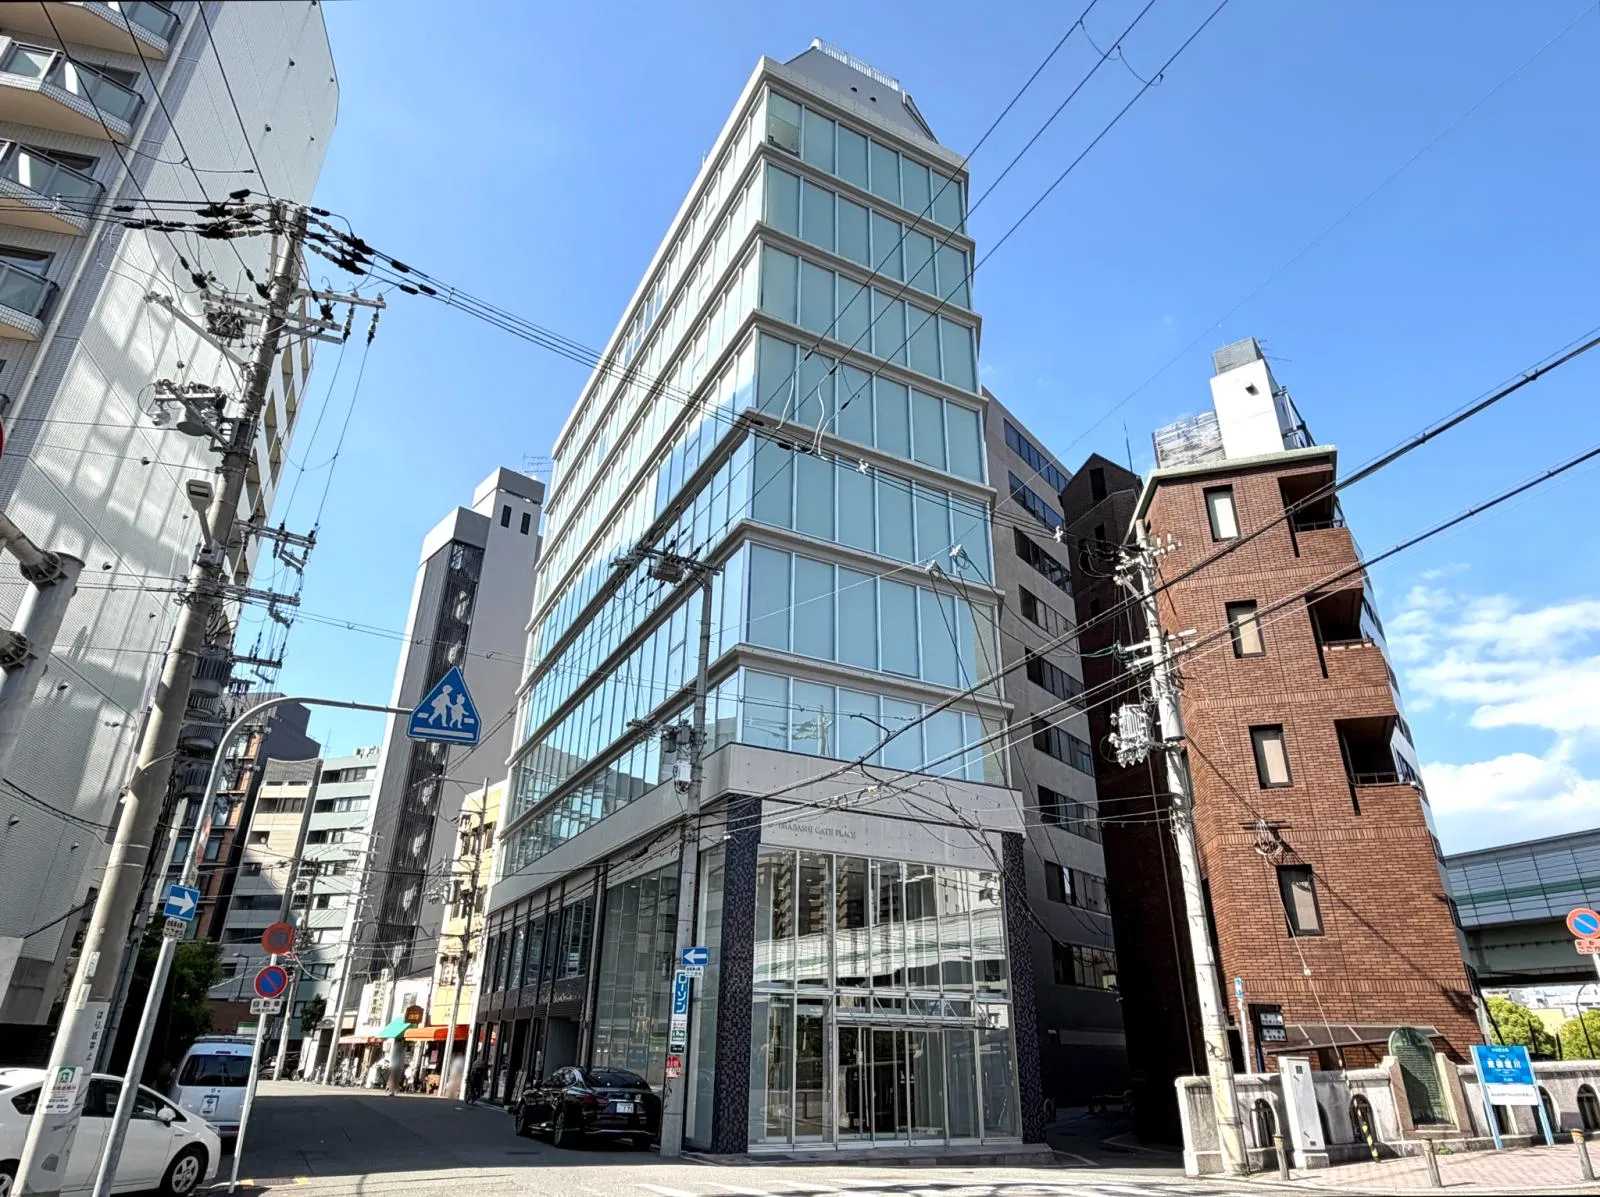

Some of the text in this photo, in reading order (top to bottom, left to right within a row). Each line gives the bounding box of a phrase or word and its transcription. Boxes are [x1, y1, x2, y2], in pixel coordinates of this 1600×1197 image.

[815, 827, 834, 837] GATE
[835, 829, 856, 840] PLACE
[676, 973, 688, 1013] ローソン
